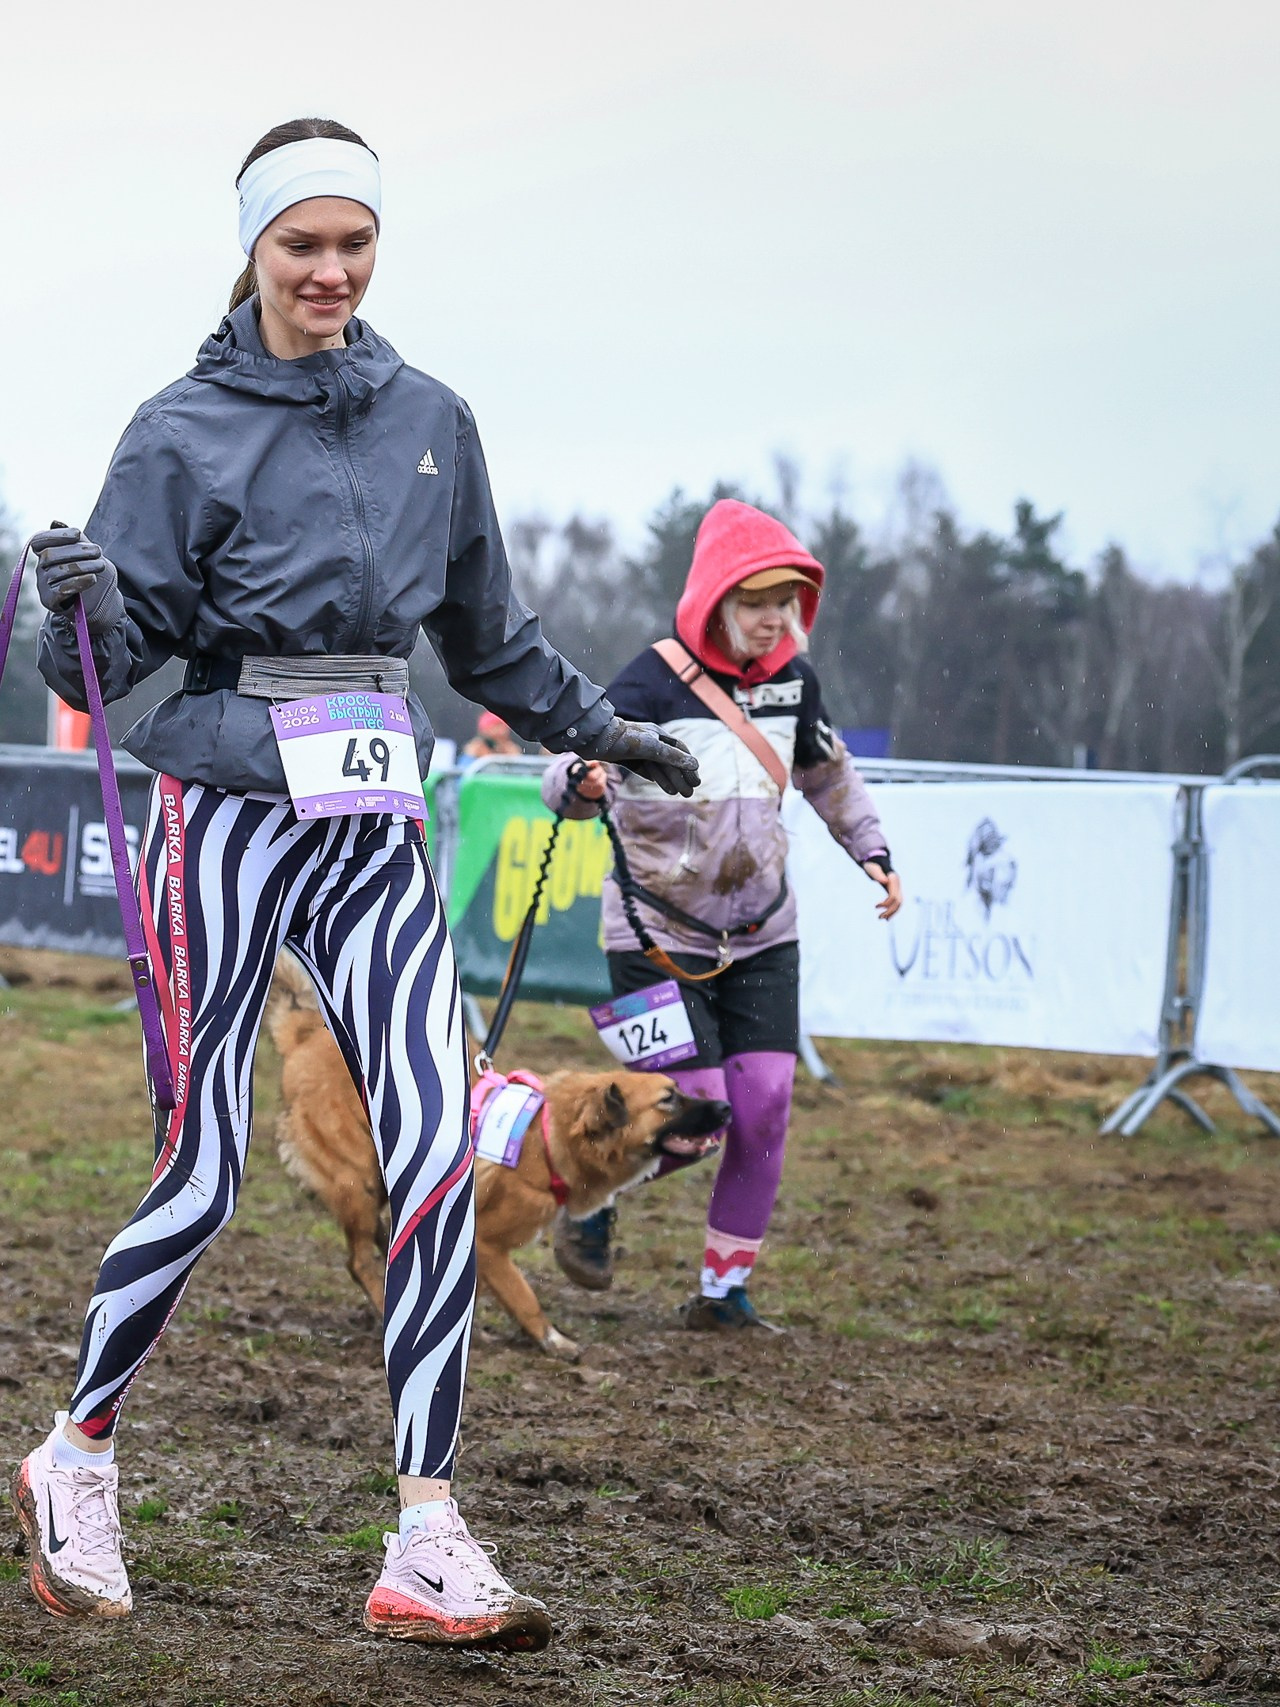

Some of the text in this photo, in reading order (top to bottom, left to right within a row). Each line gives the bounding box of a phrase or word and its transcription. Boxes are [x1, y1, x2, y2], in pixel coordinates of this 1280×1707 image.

[417, 465, 439, 476] adidas
[279, 705, 318, 719] 11/04
[281, 714, 320, 729] 2026
[389, 710, 395, 720] 2
[341, 737, 391, 782] 49
[163, 793, 182, 866] BARKA
[168, 875, 186, 937] BARKA
[173, 943, 190, 999] BARKA
[177, 1005, 190, 1056] BARKA
[618, 1017, 668, 1056] 124
[175, 1061, 188, 1104] BARKA
